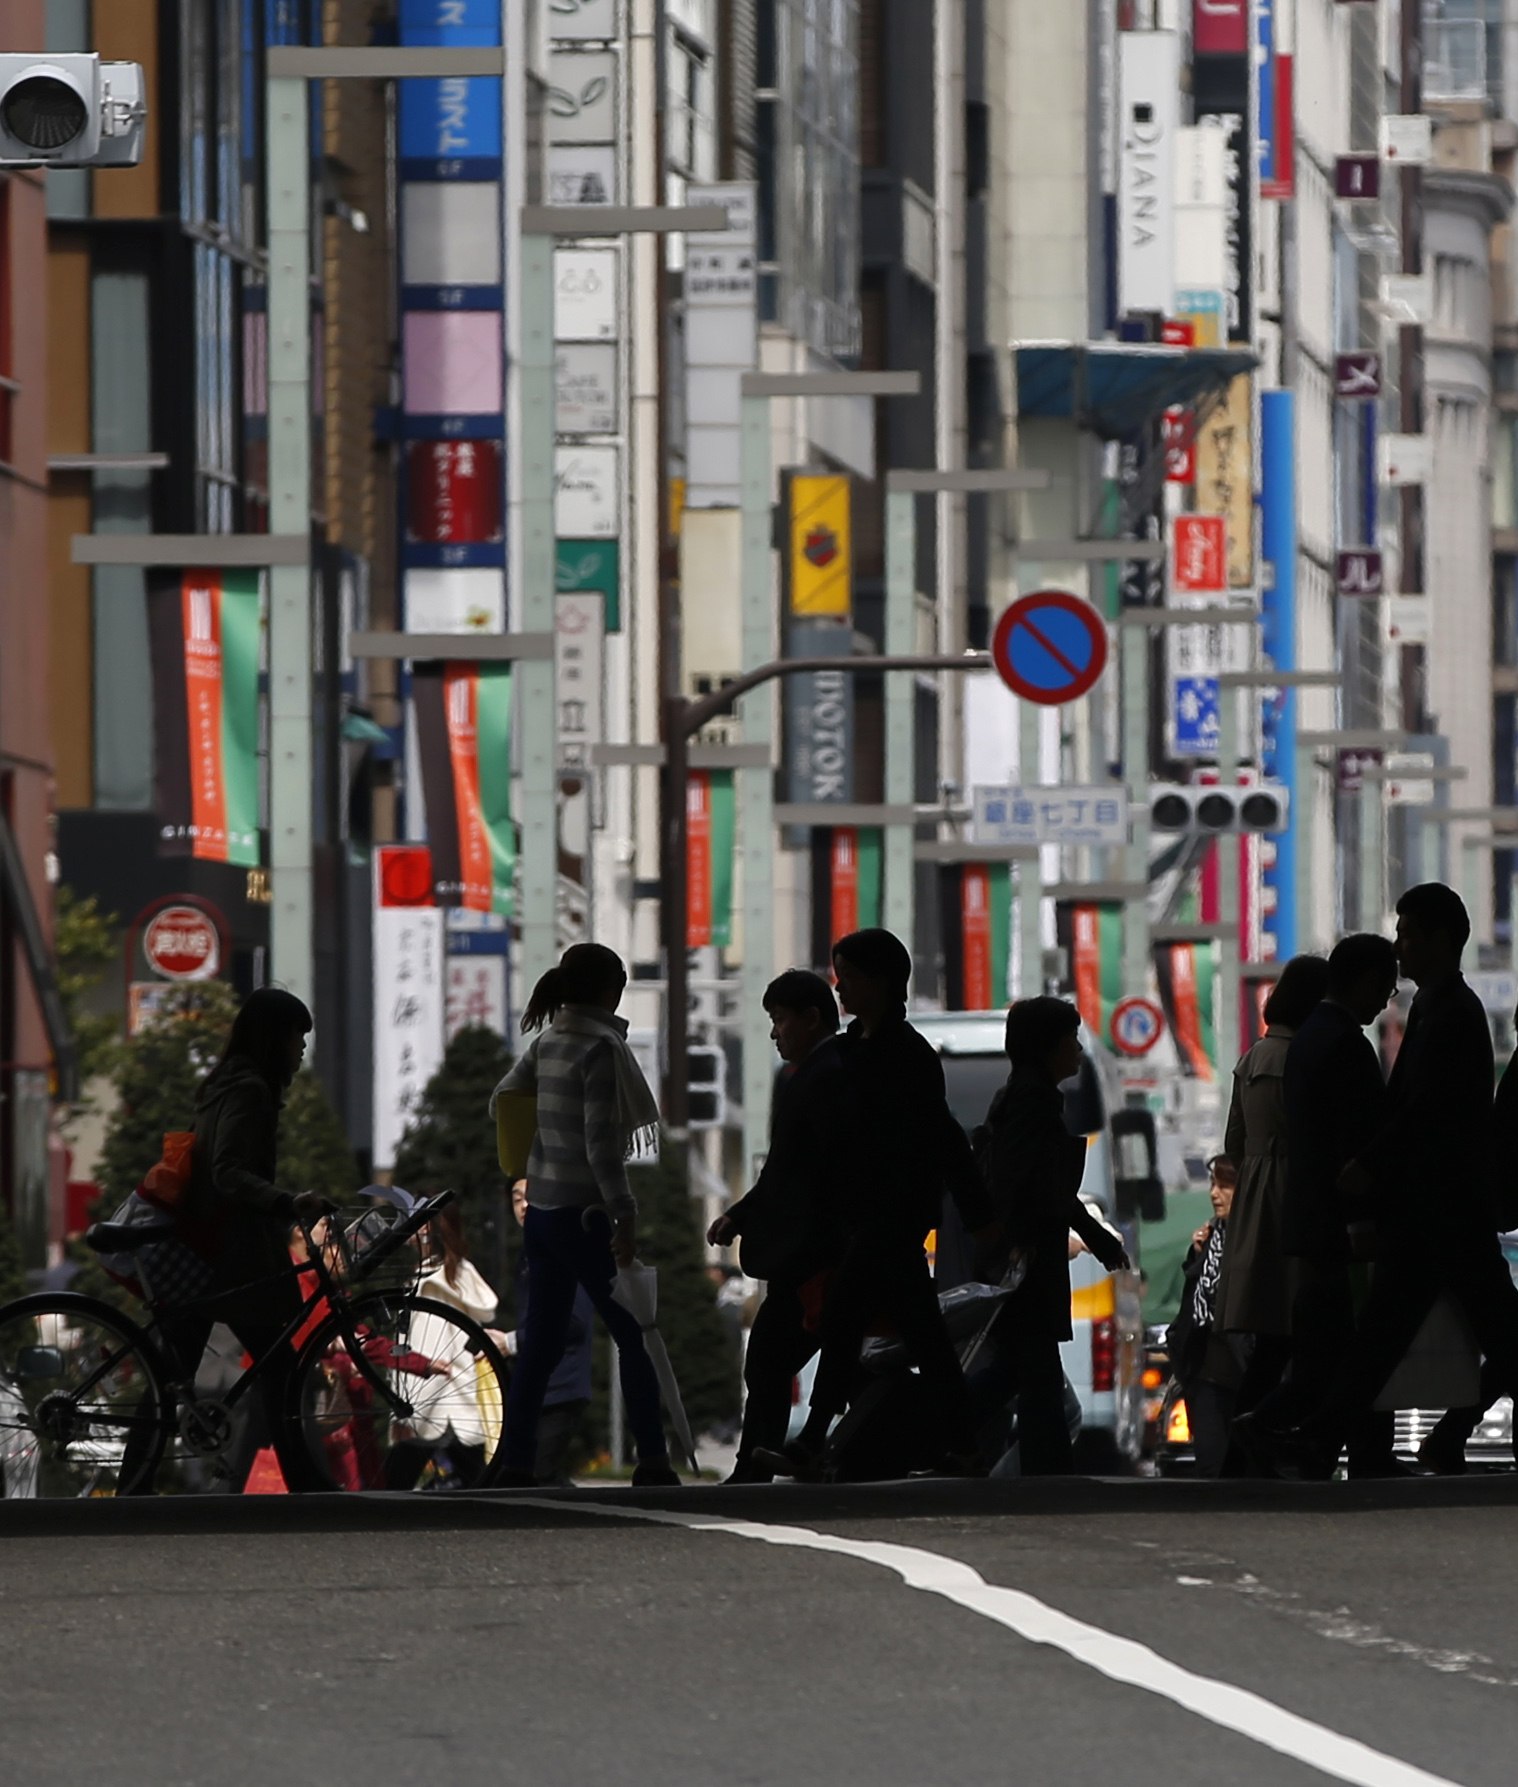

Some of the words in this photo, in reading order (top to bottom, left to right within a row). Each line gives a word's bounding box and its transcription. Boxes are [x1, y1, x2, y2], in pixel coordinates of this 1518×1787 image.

[1132, 117, 1162, 247] DIANA
[985, 801, 1120, 824] 銀座七丁目
